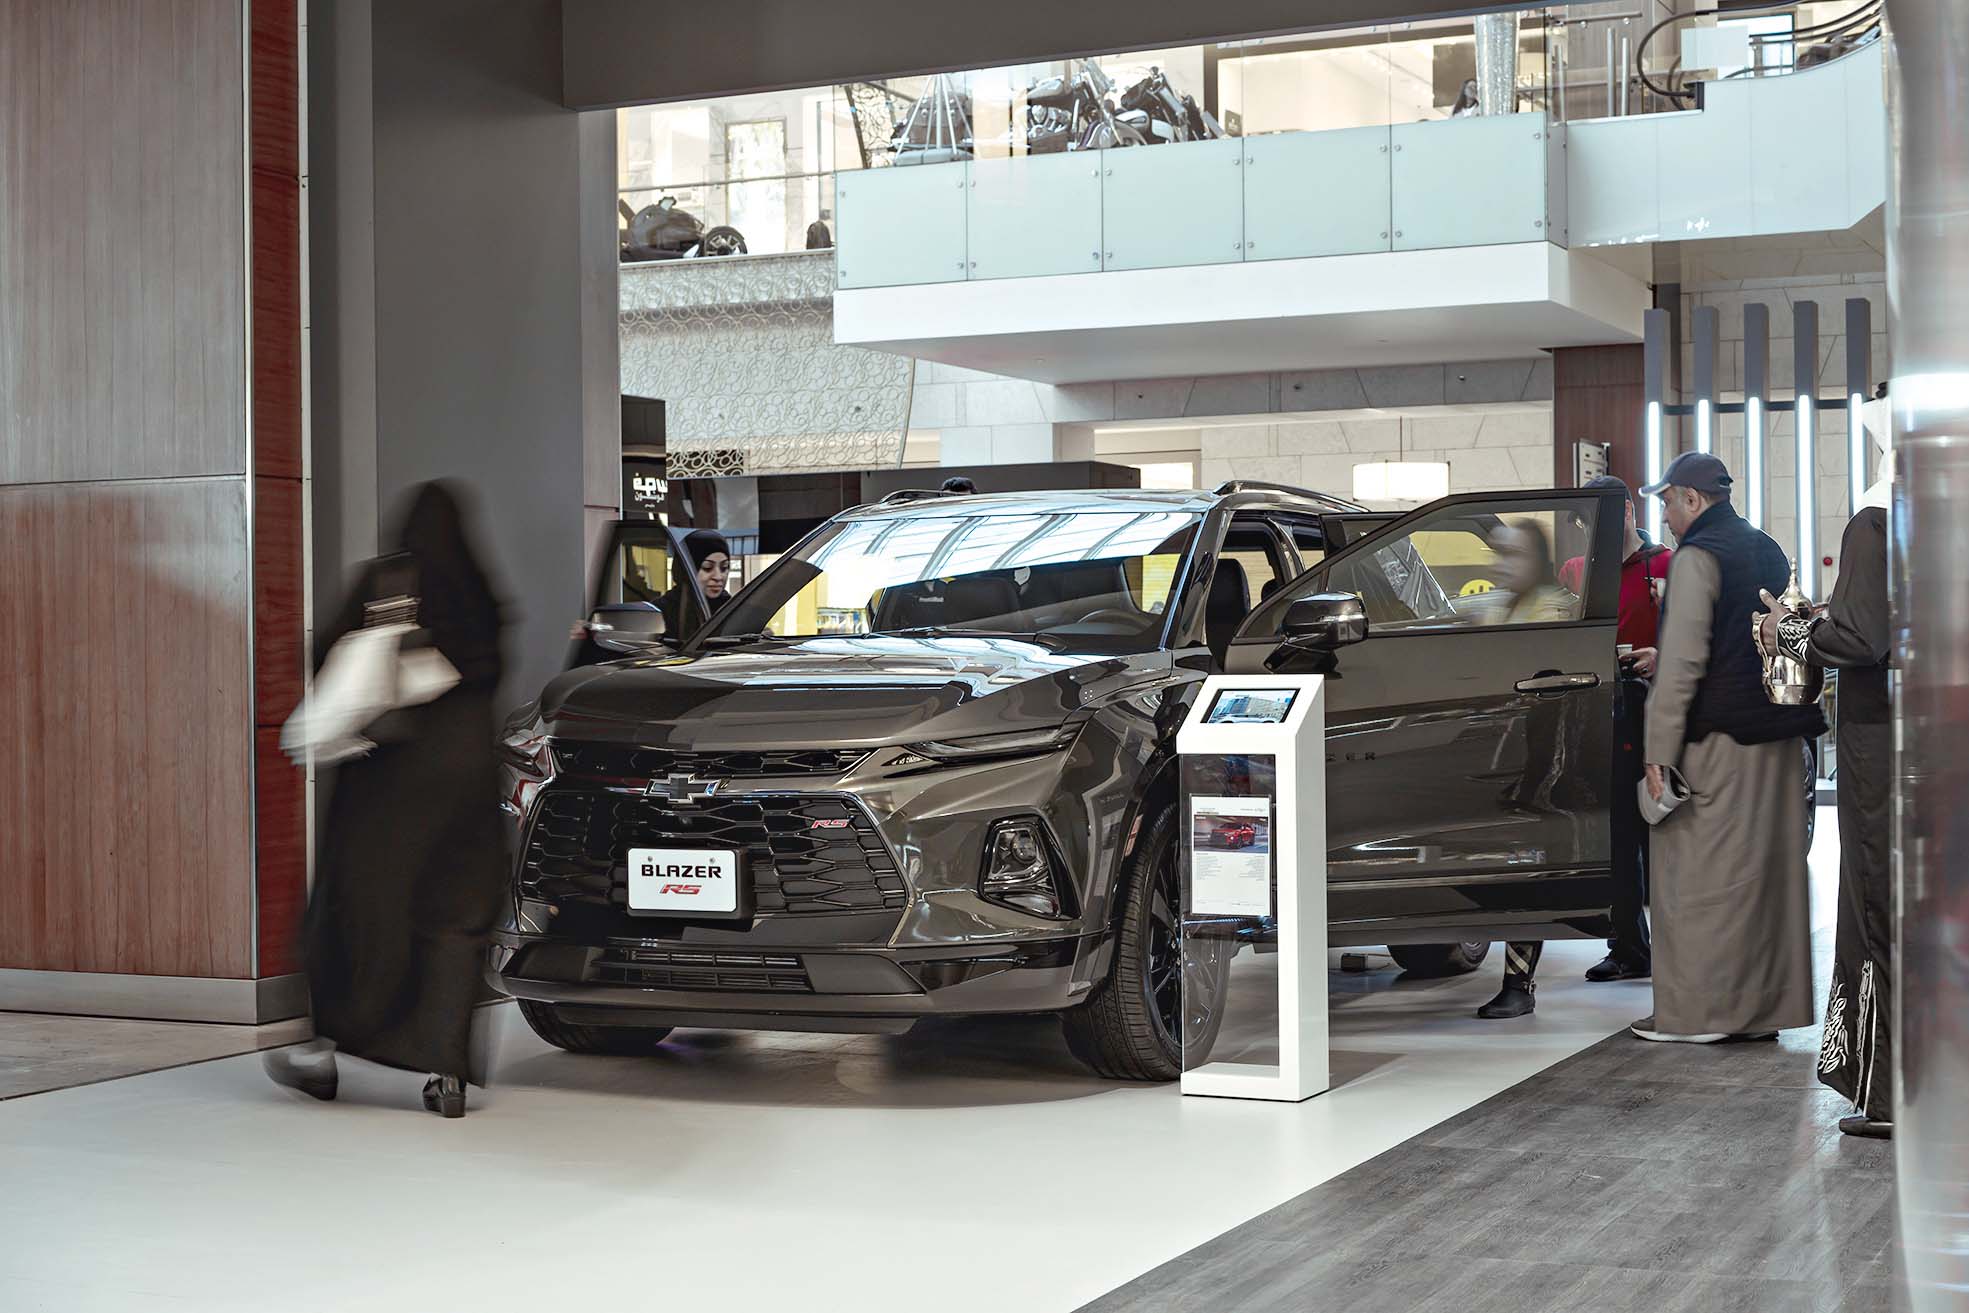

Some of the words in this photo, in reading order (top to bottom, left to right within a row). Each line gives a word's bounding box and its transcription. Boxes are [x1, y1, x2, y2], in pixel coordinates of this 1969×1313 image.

[811, 819, 850, 829] RS
[641, 864, 722, 878] BLAZER
[659, 883, 702, 895] RS
